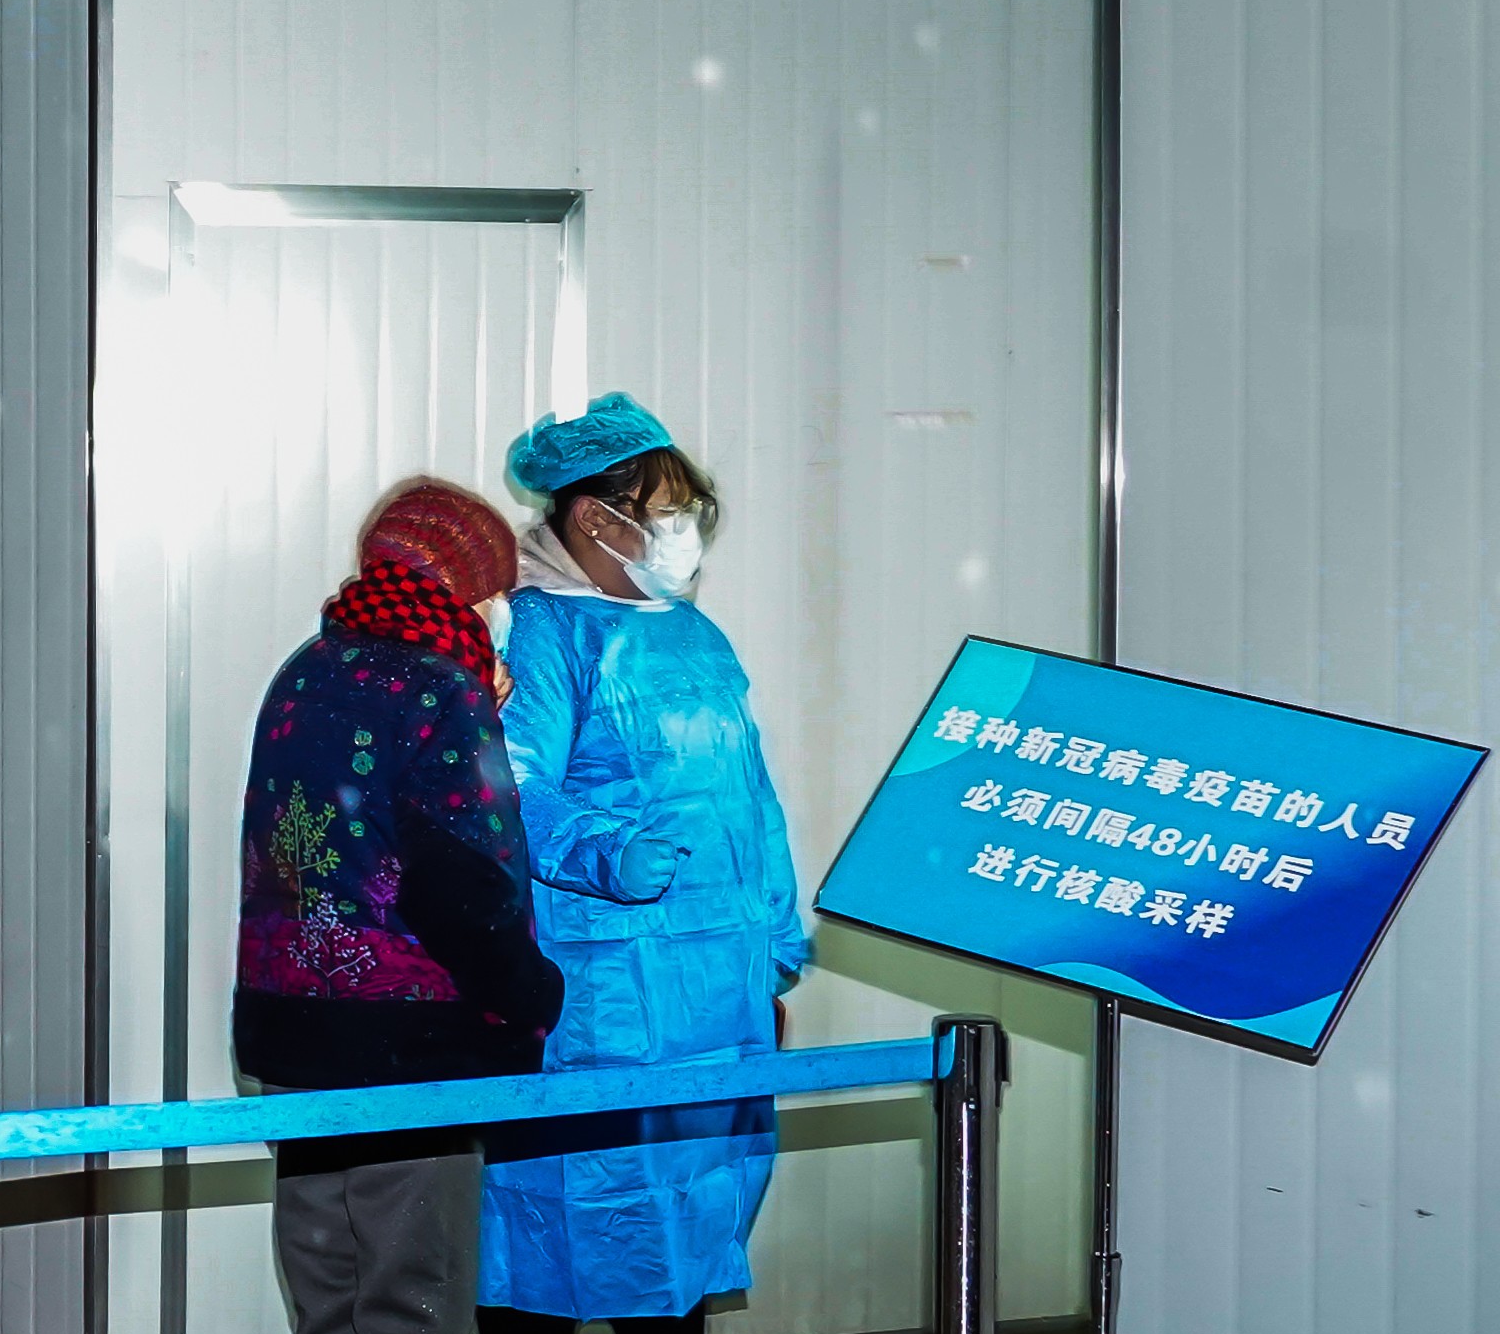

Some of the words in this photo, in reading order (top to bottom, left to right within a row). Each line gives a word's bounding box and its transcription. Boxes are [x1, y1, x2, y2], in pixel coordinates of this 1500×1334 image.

[933, 705, 1417, 851] 接种新冠病毒疫苗的人员
[960, 780, 1314, 893] 必须间隔48小时后
[968, 843, 1235, 939] 进行核酸采样
